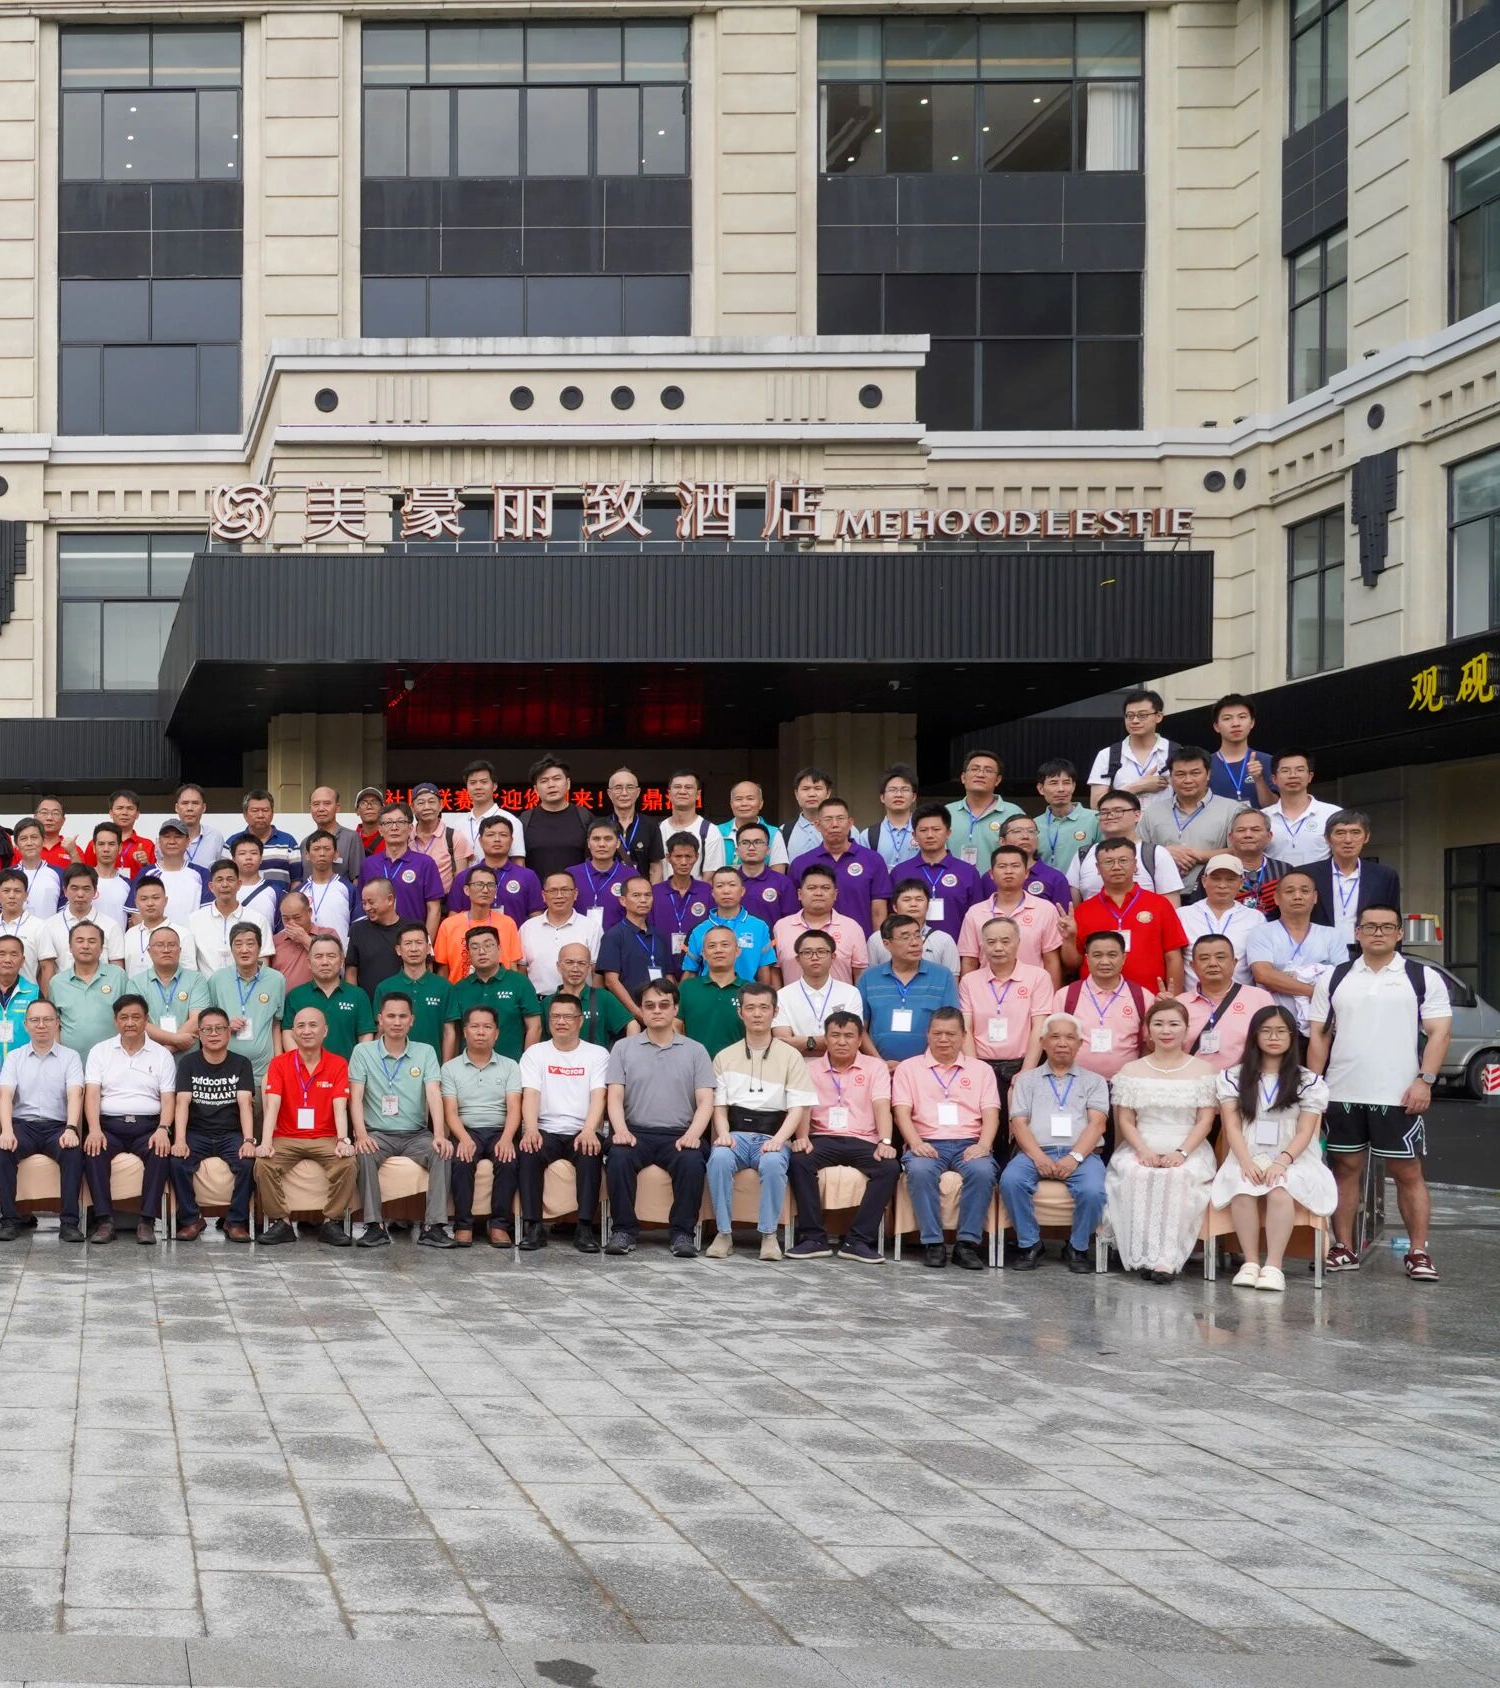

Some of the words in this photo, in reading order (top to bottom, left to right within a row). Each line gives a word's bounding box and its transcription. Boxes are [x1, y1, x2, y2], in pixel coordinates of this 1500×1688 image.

[301, 480, 826, 541] 美豪丽致酒店
[192, 1090, 237, 1100] GERMANY
